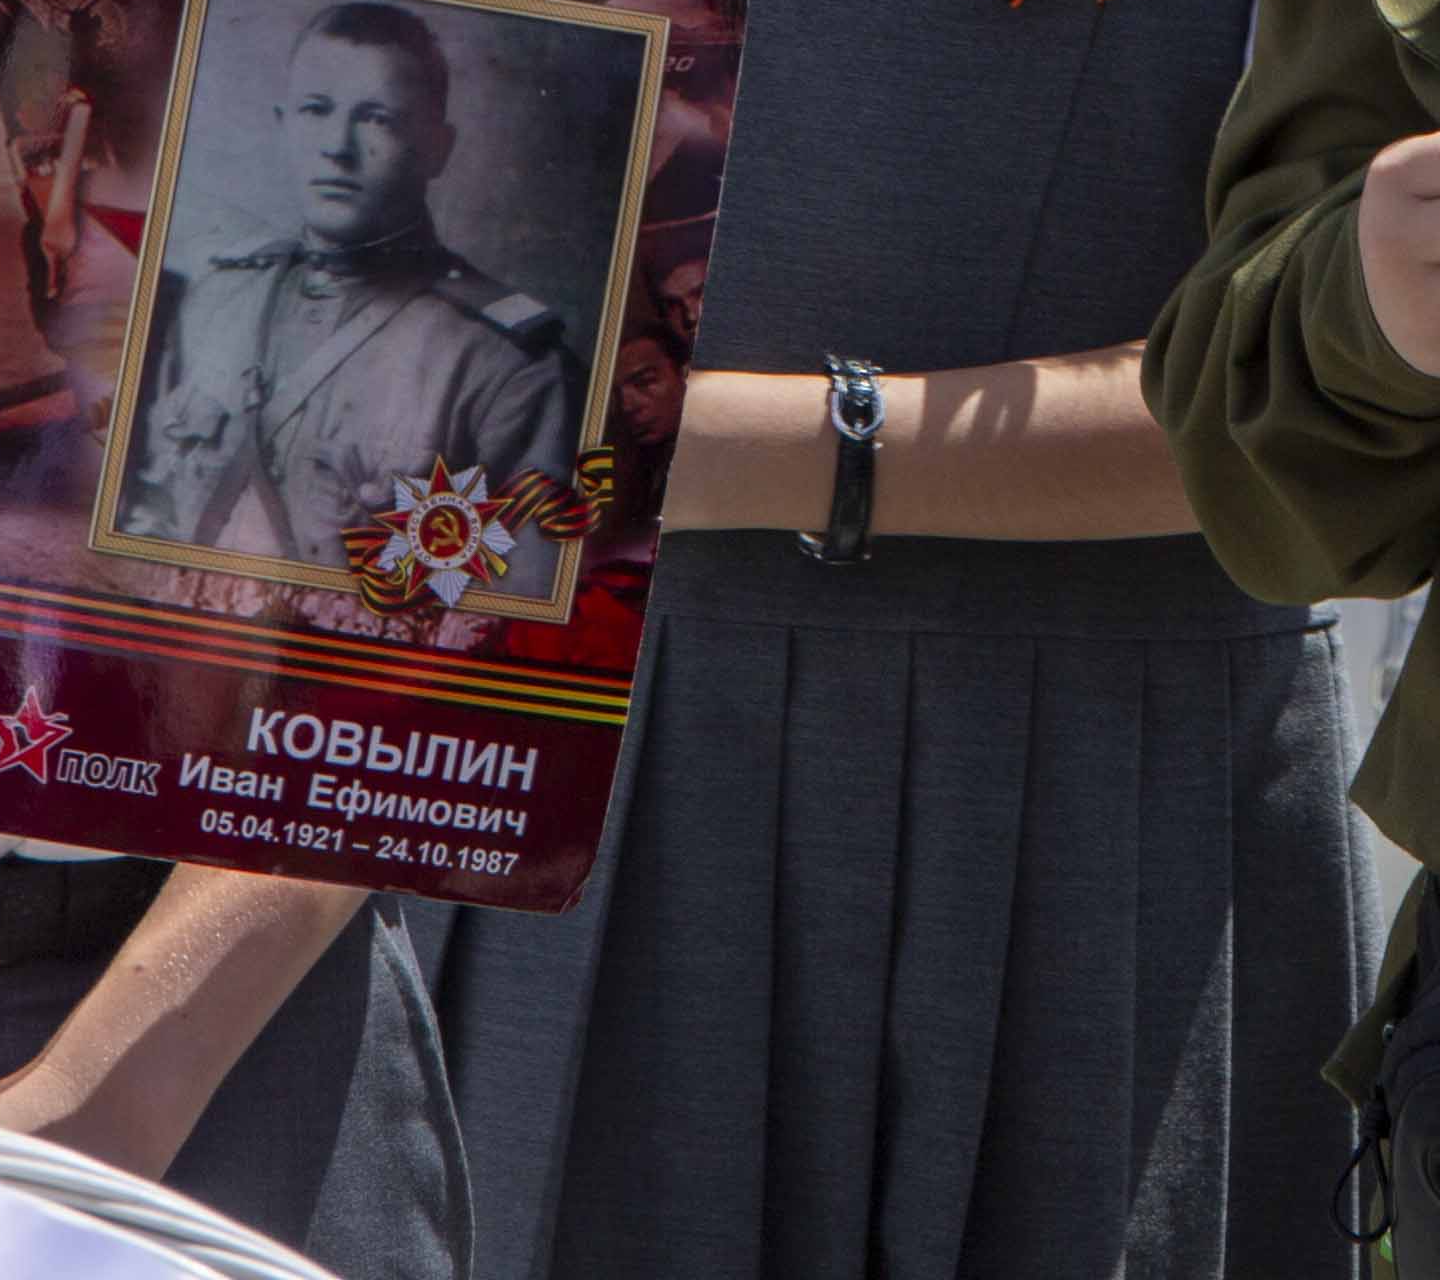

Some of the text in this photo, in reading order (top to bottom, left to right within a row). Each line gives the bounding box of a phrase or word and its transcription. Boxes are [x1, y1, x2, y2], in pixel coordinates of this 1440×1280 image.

[245, 706, 539, 792] КОВЫЛИН
[178, 751, 528, 837] Иван Ефимович
[200, 808, 344, 853] 05.04.1921
[375, 834, 519, 877] 24.10.1987
